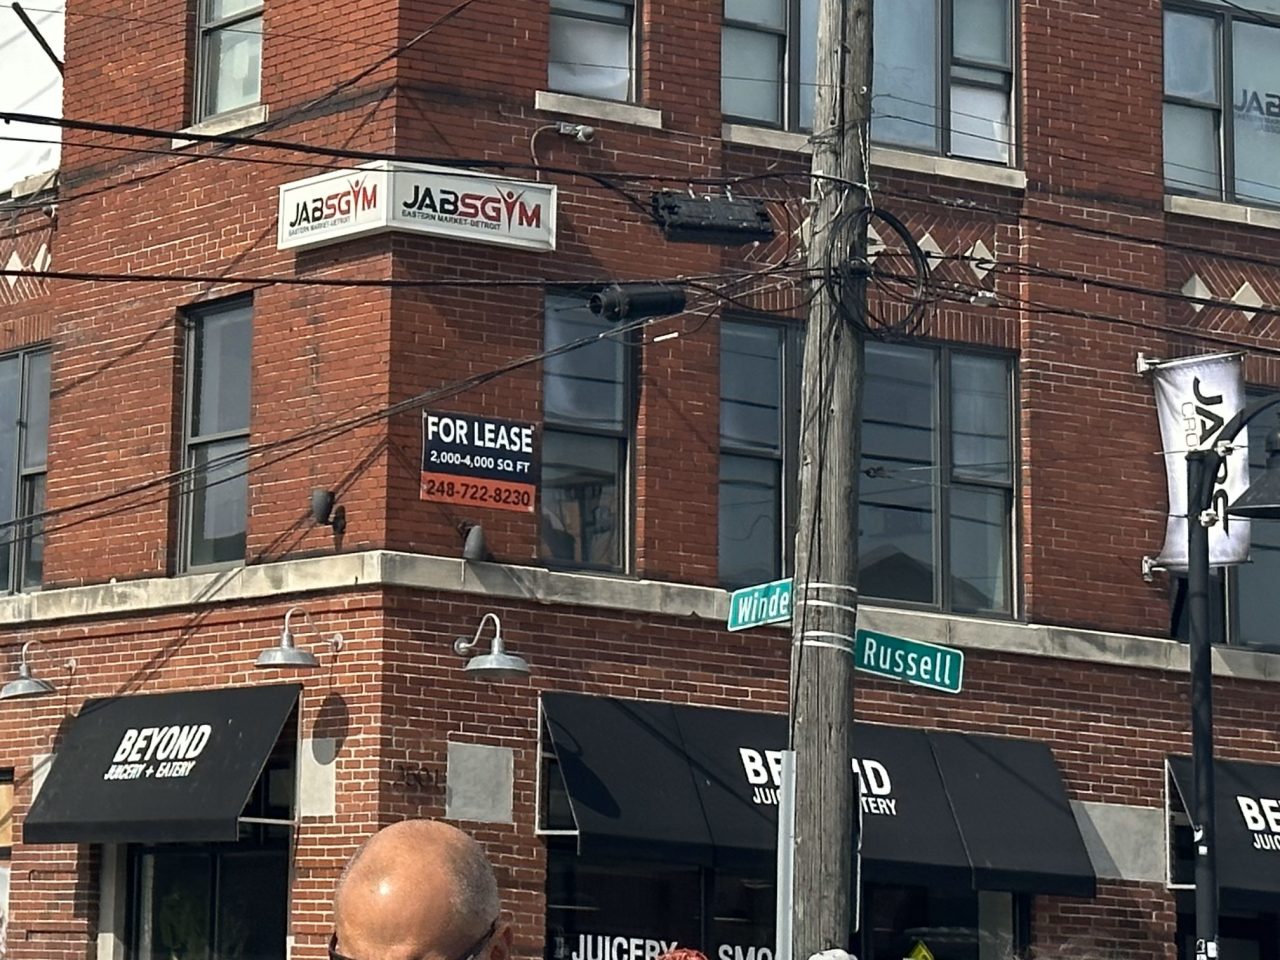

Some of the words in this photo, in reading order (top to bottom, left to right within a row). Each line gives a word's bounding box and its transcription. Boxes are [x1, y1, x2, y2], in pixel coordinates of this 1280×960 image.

[402, 210, 437, 221] EASTERN
[427, 415, 468, 445] FOR
[474, 422, 533, 453] LEASE
[430, 450, 494, 469] 2,000-4,000
[497, 459, 514, 471] SQ
[516, 461, 531, 473] FT
[426, 479, 531, 506] 248-722-8230
[738, 586, 790, 624] Winde
[863, 637, 952, 685] Russell
[113, 724, 212, 762] BEYOND
[103, 762, 147, 780] JUICERY
[155, 760, 197, 779] EATERY
[1236, 795, 1280, 833] BE
